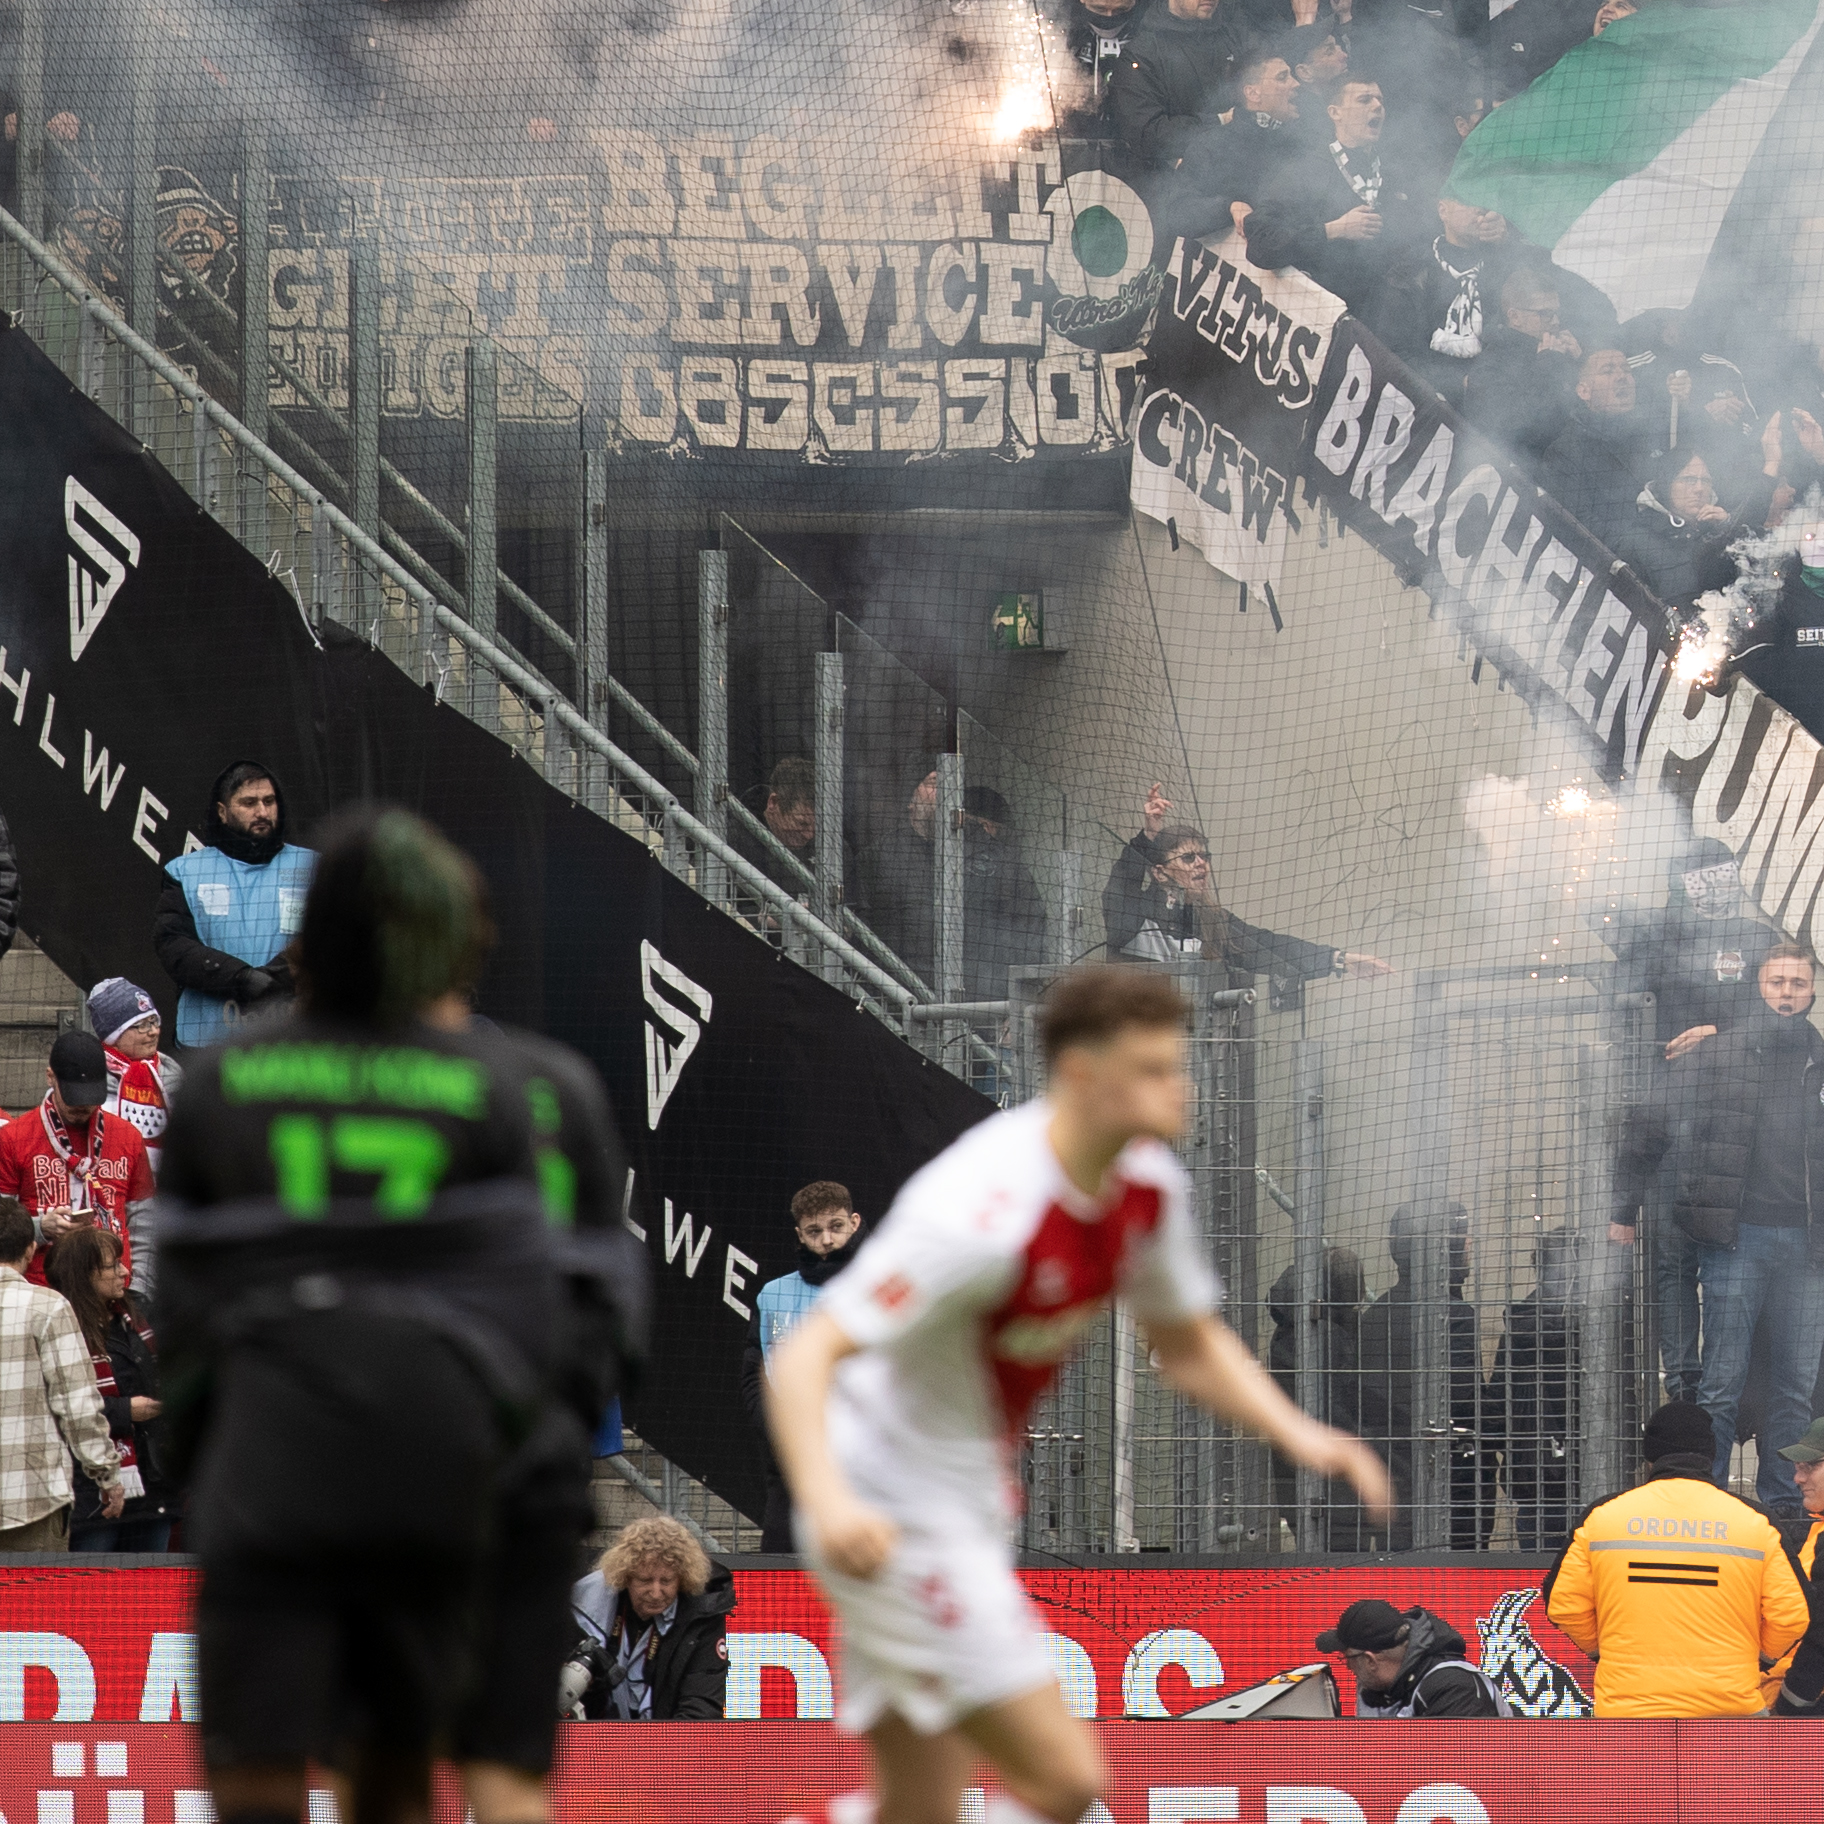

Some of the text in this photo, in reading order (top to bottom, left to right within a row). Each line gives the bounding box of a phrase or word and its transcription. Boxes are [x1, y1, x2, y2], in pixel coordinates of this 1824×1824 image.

[605, 237, 1047, 349] SERVICE
[1158, 234, 1322, 411] VITUS
[1133, 389, 1301, 545] CREW
[266, 1112, 453, 1220] 17
[1626, 1516, 1730, 1541] ORDNER
